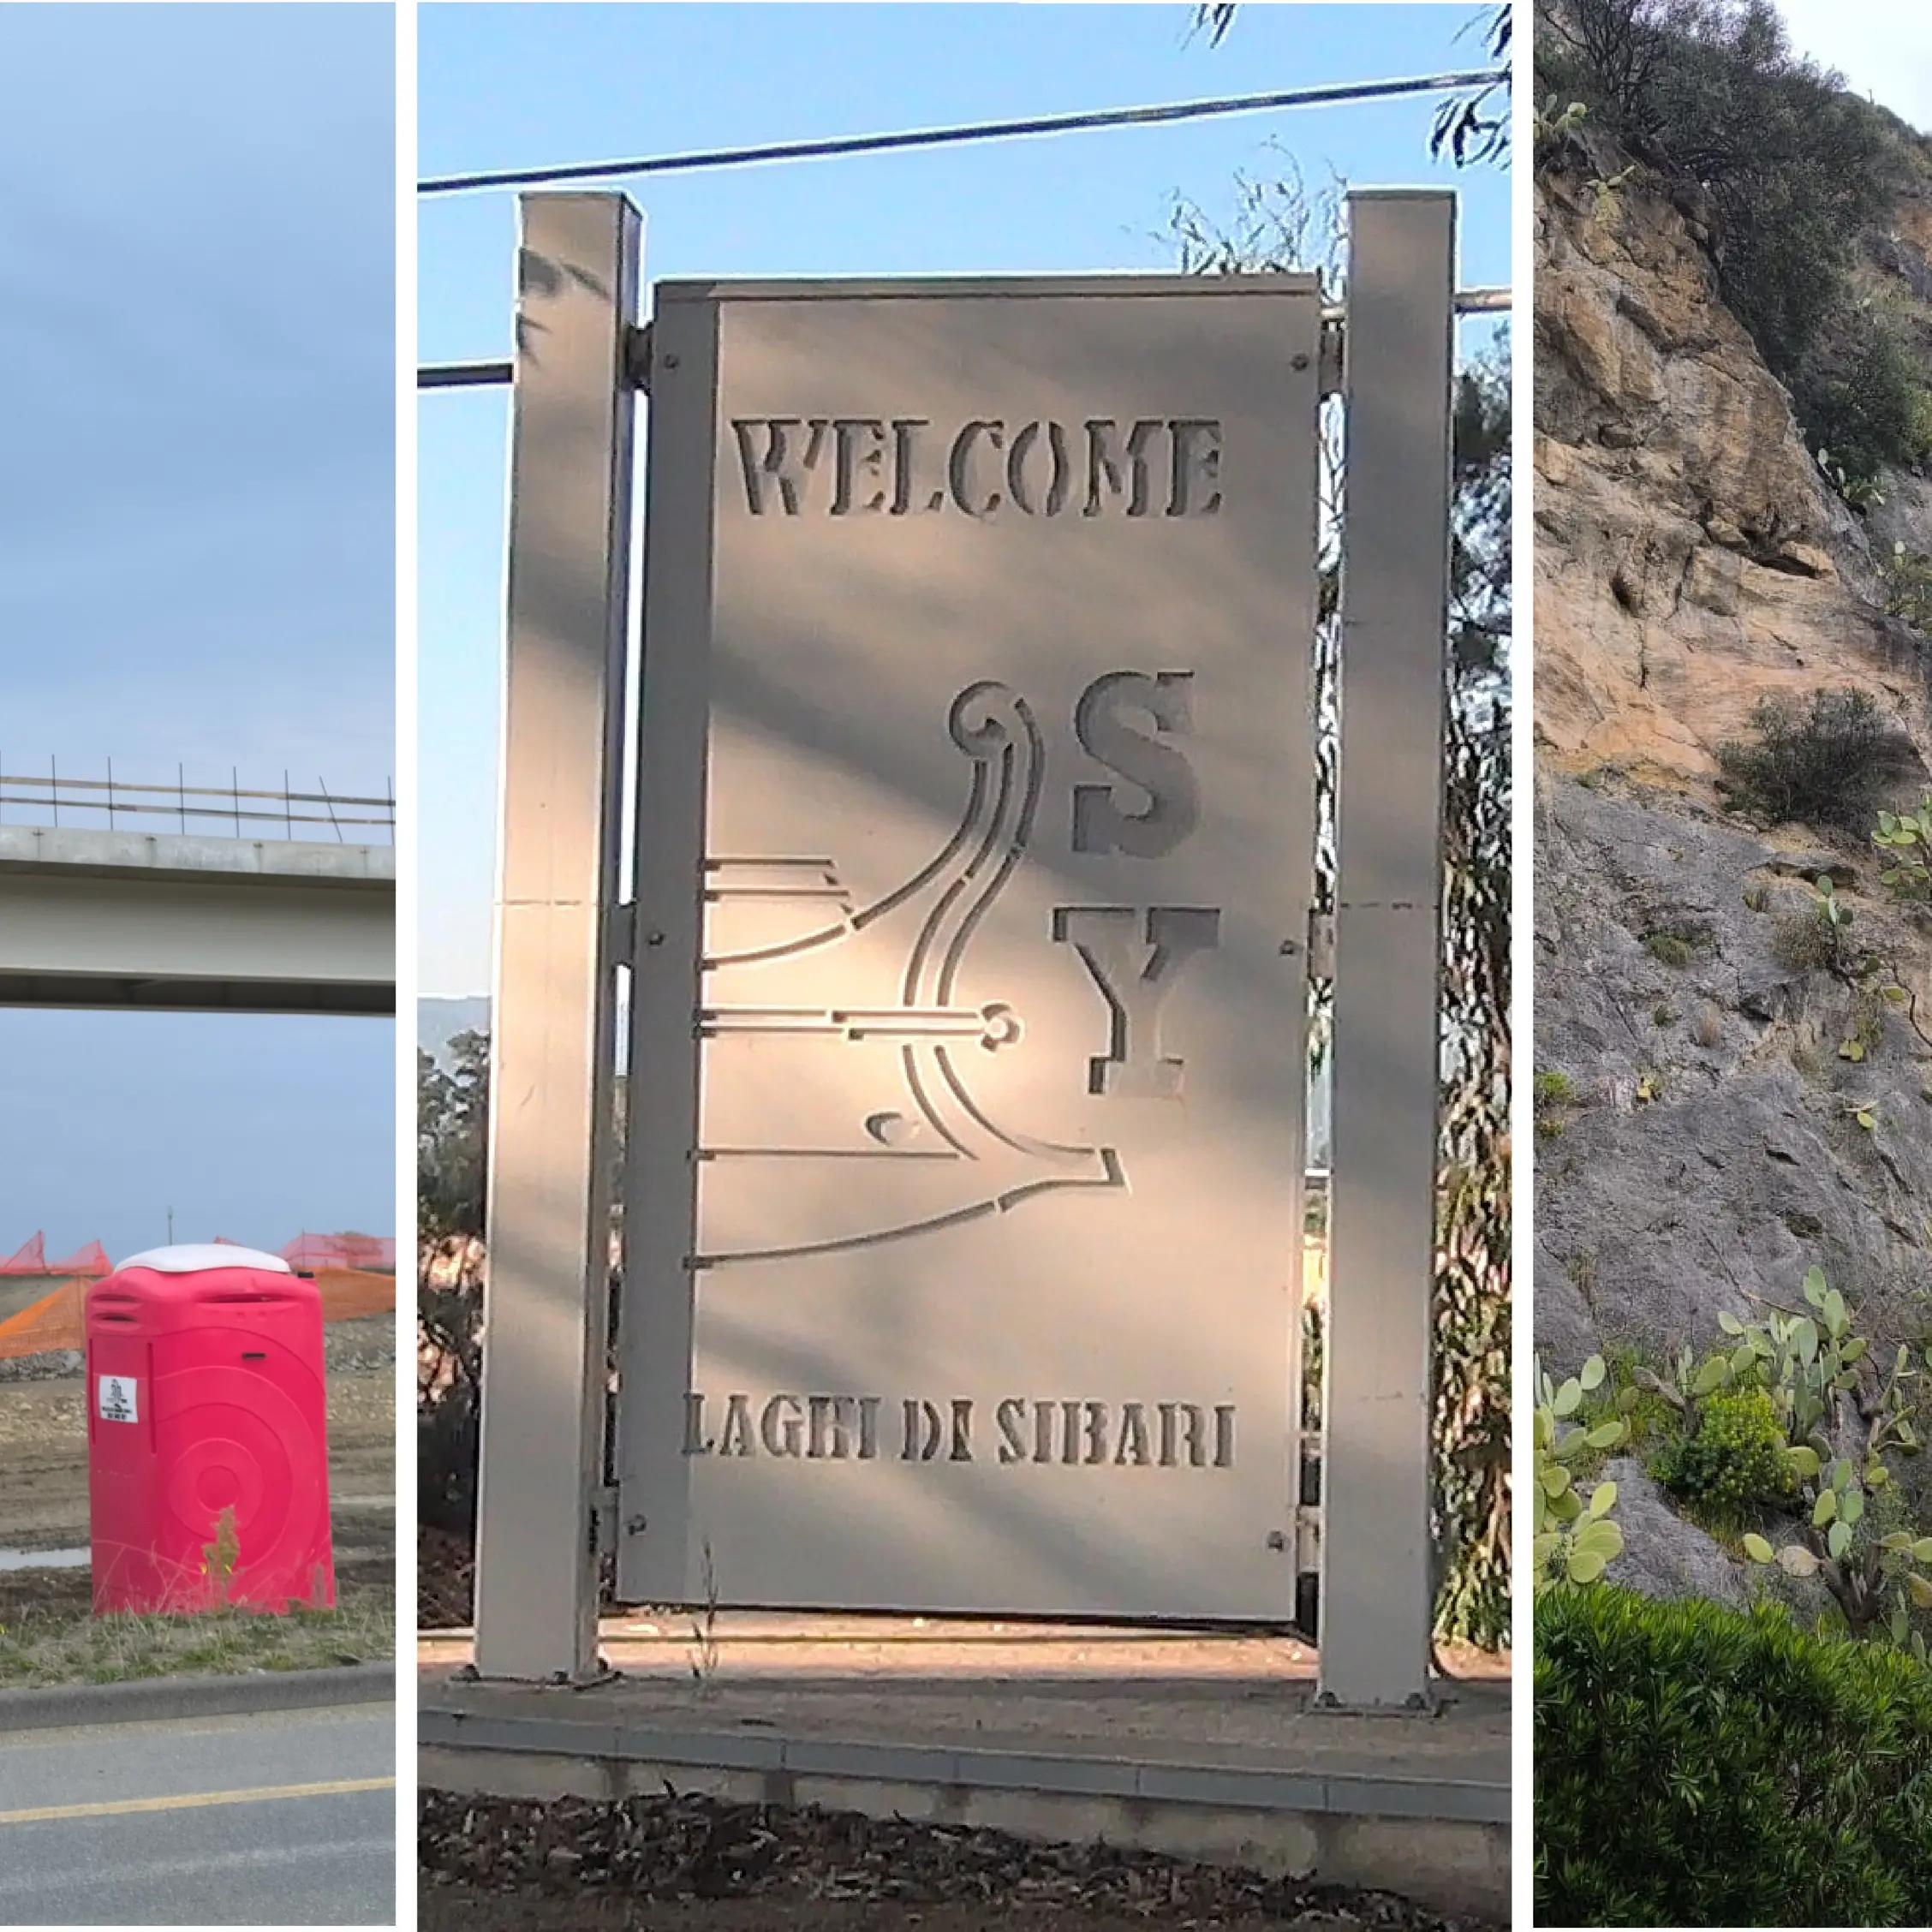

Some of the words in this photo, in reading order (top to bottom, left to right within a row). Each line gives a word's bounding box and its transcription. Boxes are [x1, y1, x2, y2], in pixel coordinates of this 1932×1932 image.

[730, 416, 1222, 519] WELCOME
[1071, 670, 1197, 860] S
[1052, 905, 1220, 1100] Y
[682, 1392, 882, 1462] LAGHI
[900, 1398, 974, 1461] DI
[995, 1398, 1237, 1468] SIBARI
